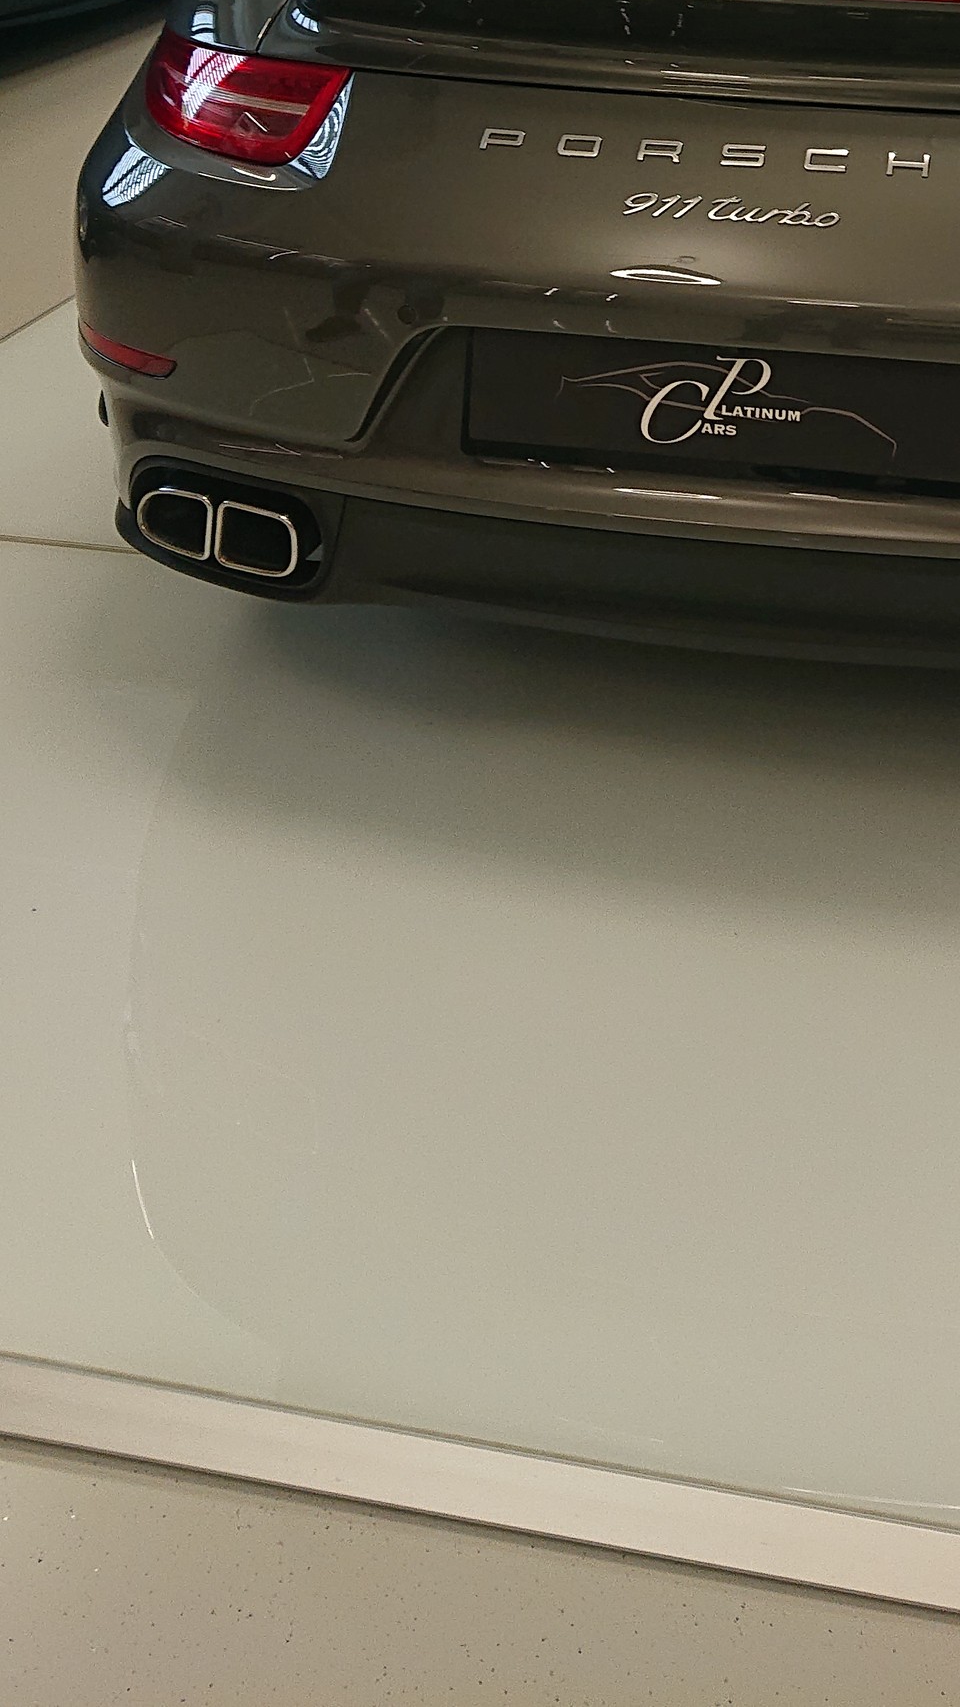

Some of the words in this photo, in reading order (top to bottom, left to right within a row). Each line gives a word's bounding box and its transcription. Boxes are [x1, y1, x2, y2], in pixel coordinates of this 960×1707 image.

[622, 192, 703, 219] 911
[707, 195, 841, 228] turbo
[640, 380, 737, 444] CARS
[703, 355, 801, 422] PLATINUM
